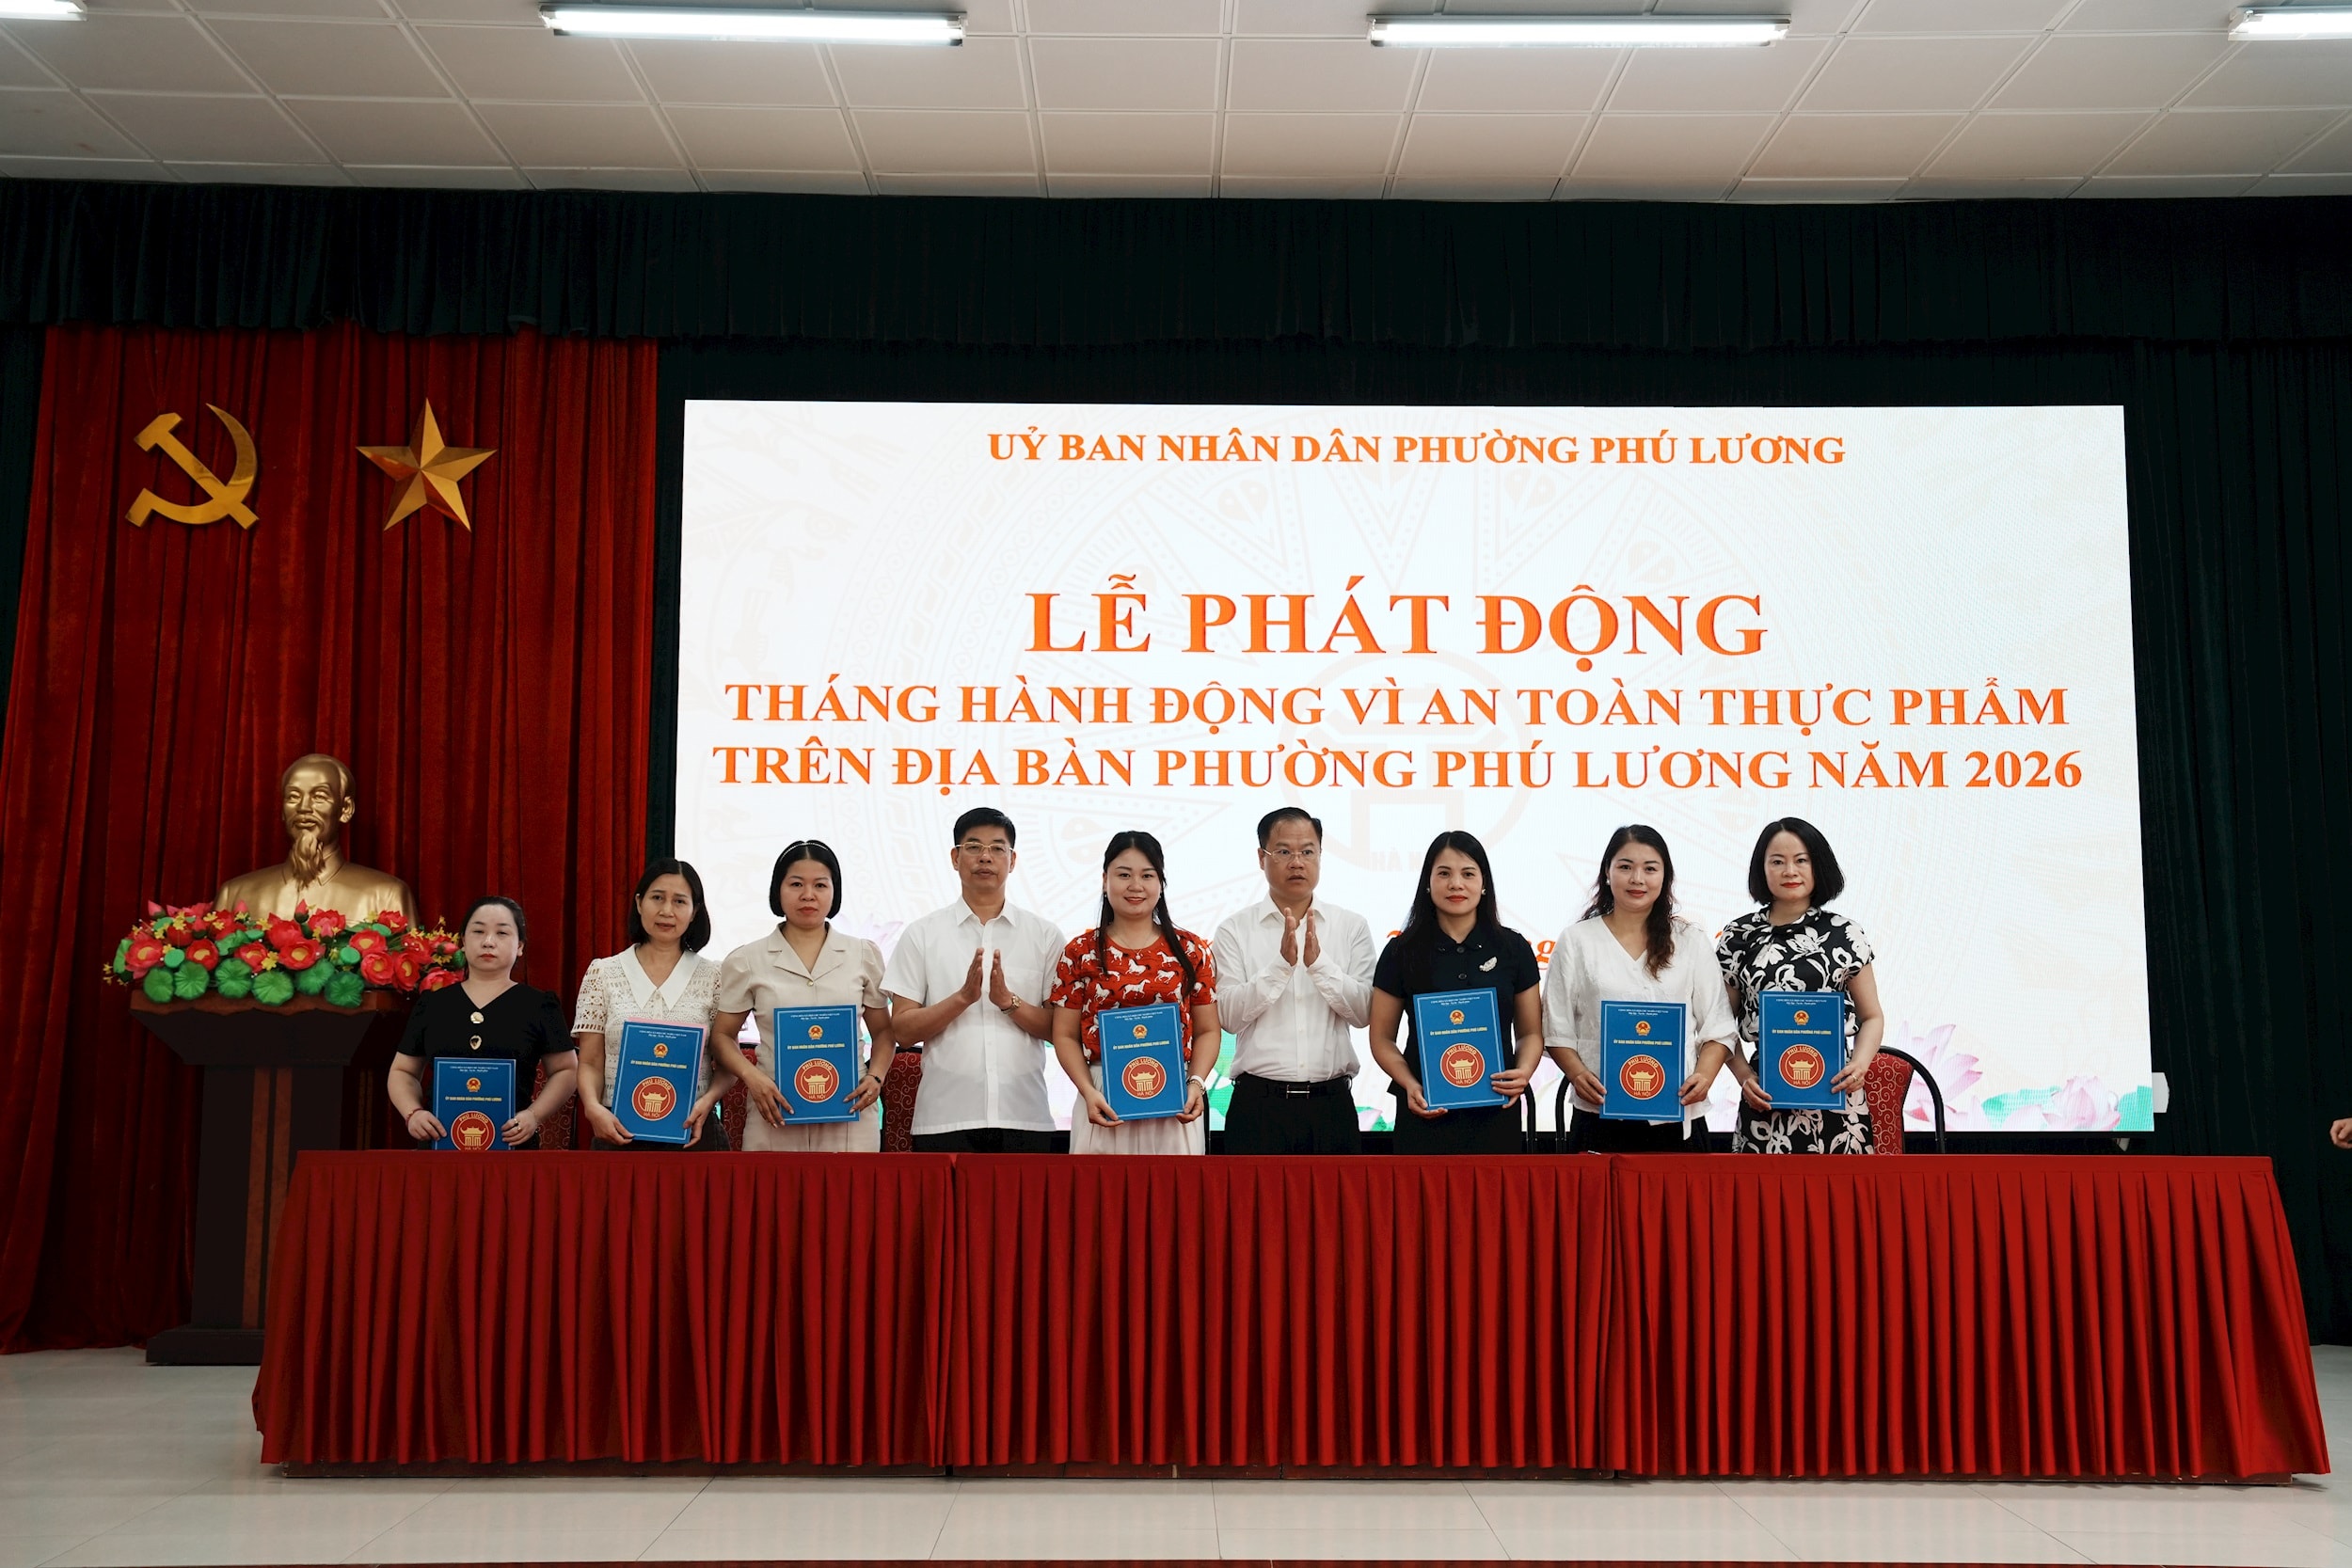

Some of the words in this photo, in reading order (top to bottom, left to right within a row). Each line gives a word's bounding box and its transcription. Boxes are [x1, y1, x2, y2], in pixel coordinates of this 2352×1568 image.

[989, 426, 1047, 461] UỶ
[1059, 434, 1145, 462] BAN
[1159, 427, 1279, 462] NHÂN
[1292, 428, 1381, 463] DÂN
[1394, 429, 1580, 464] PHƯỜNG
[1591, 429, 1677, 465] PHÚ
[1690, 432, 1846, 465] LƯƠNG
[1025, 574, 1151, 653] LỄ
[1183, 575, 1450, 655] PHÁT
[1475, 583, 1768, 673] ĐỘNG
[724, 673, 939, 722] THÁNG
[960, 674, 1133, 723] HÀNH
[1150, 681, 1324, 735] ĐỘNG
[1342, 677, 1403, 725] VÌ
[1417, 688, 1499, 725] AN
[1517, 678, 1682, 726] TOÀN
[1699, 683, 1872, 736] THỰC
[1890, 676, 2070, 726] PHẨM
[712, 736, 874, 784] TRÊN
[892, 747, 1000, 797] ĐỊA
[1013, 737, 1136, 786] BÀN
[1153, 747, 1415, 788] PHƯỜNG
[1433, 740, 1556, 788] PHÚ
[1572, 745, 1792, 789] LƯƠNG
[1807, 740, 1949, 789] NĂM
[1964, 750, 2083, 788] 2026
